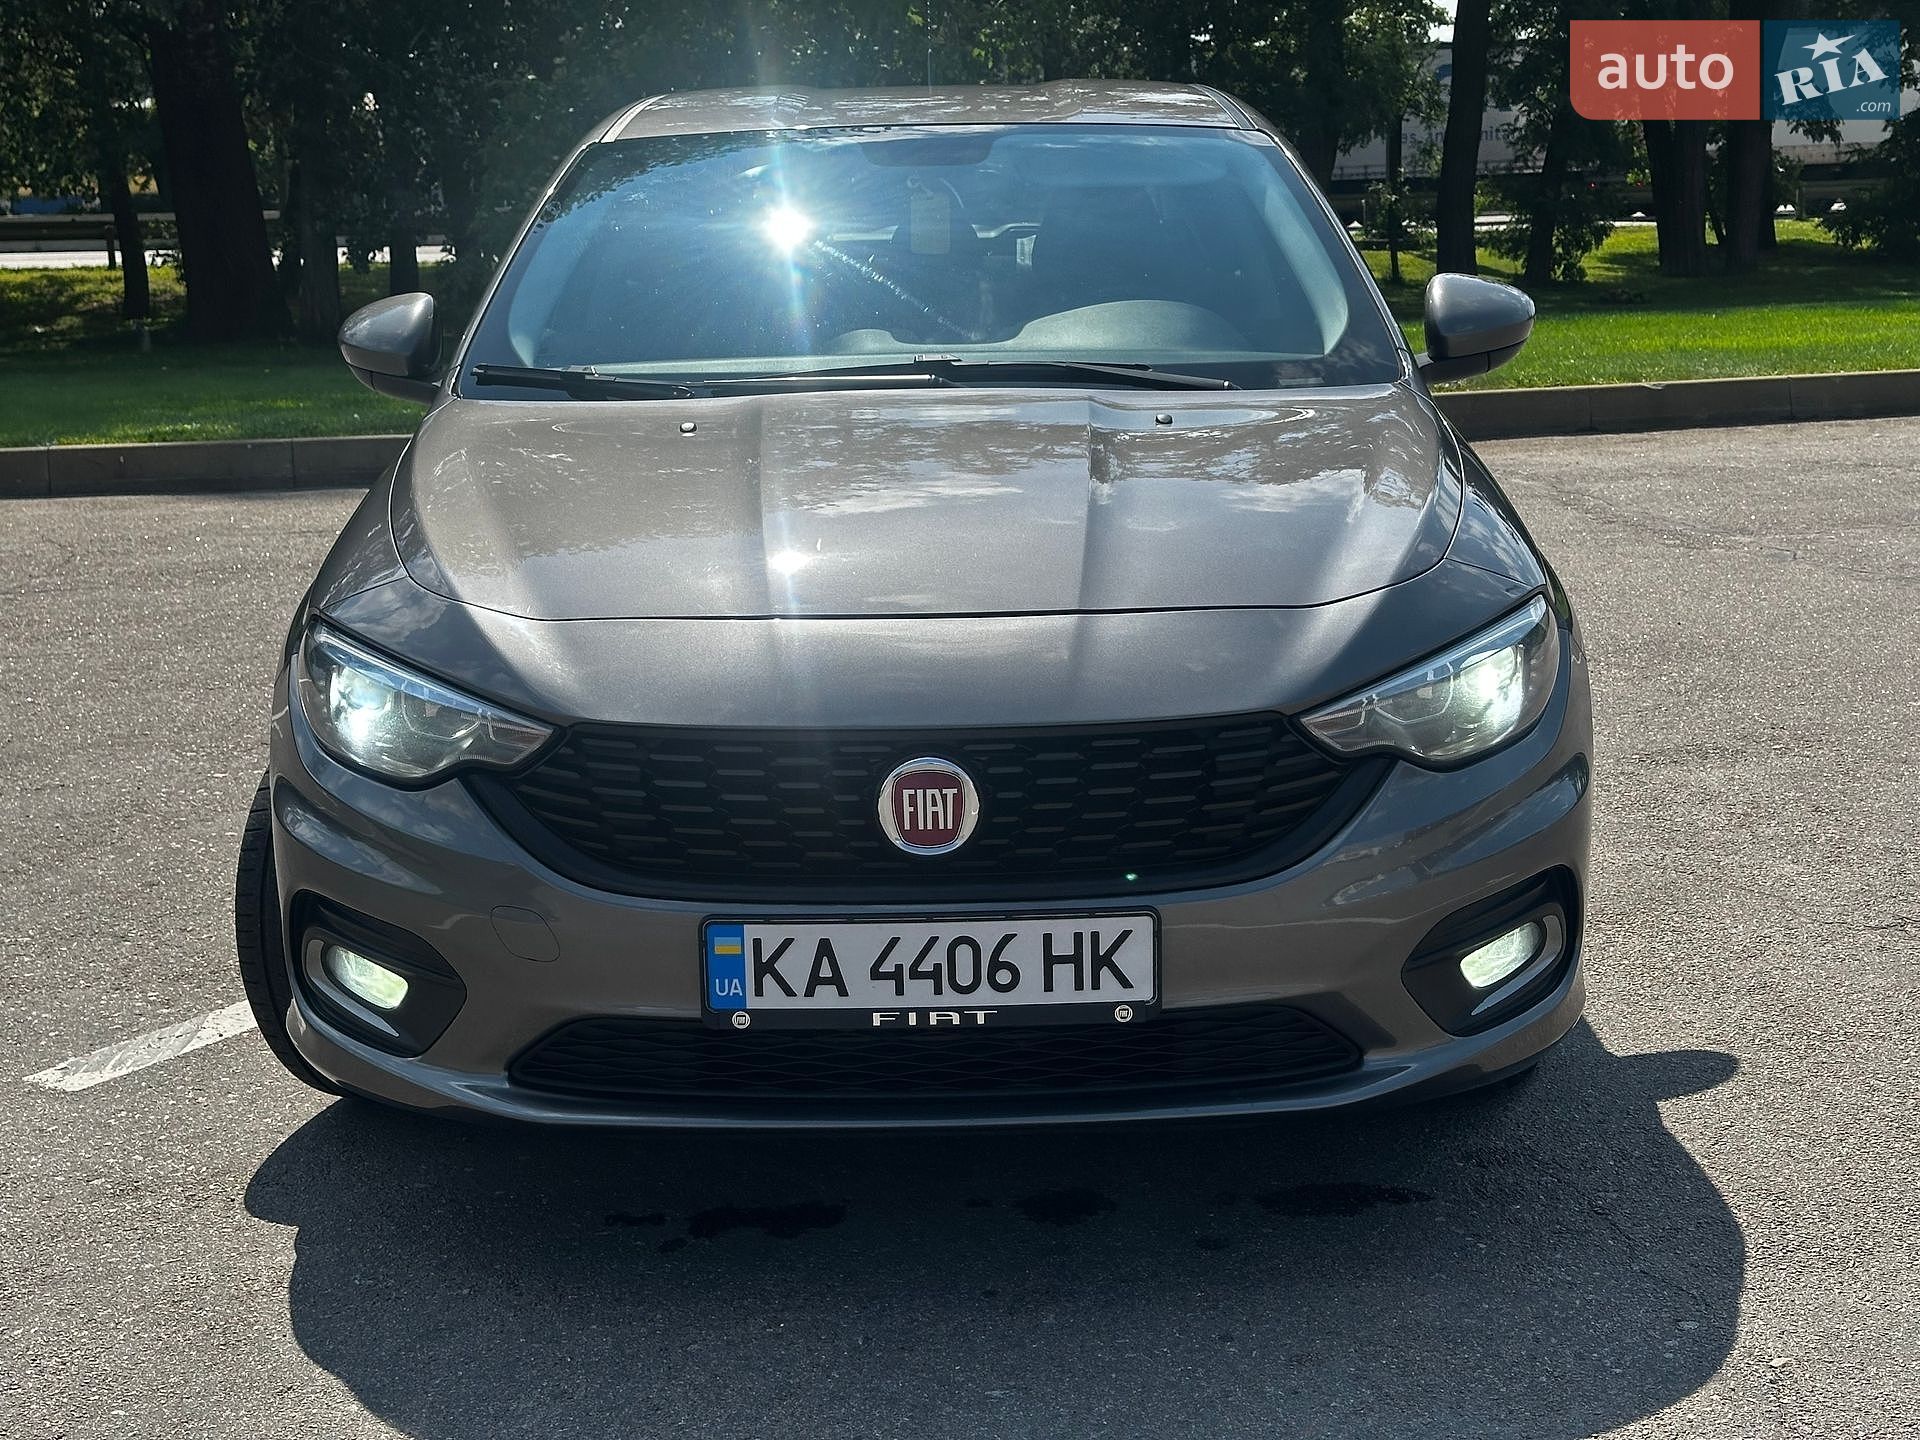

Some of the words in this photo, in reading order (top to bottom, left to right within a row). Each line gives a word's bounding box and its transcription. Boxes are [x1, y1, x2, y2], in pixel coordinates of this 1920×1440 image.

[902, 788, 958, 830] FIAT
[752, 937, 849, 998] KA
[869, 933, 1021, 996] 4406
[1043, 929, 1134, 992] HK
[715, 978, 743, 996] UA
[872, 1010, 998, 1026] FIAT
